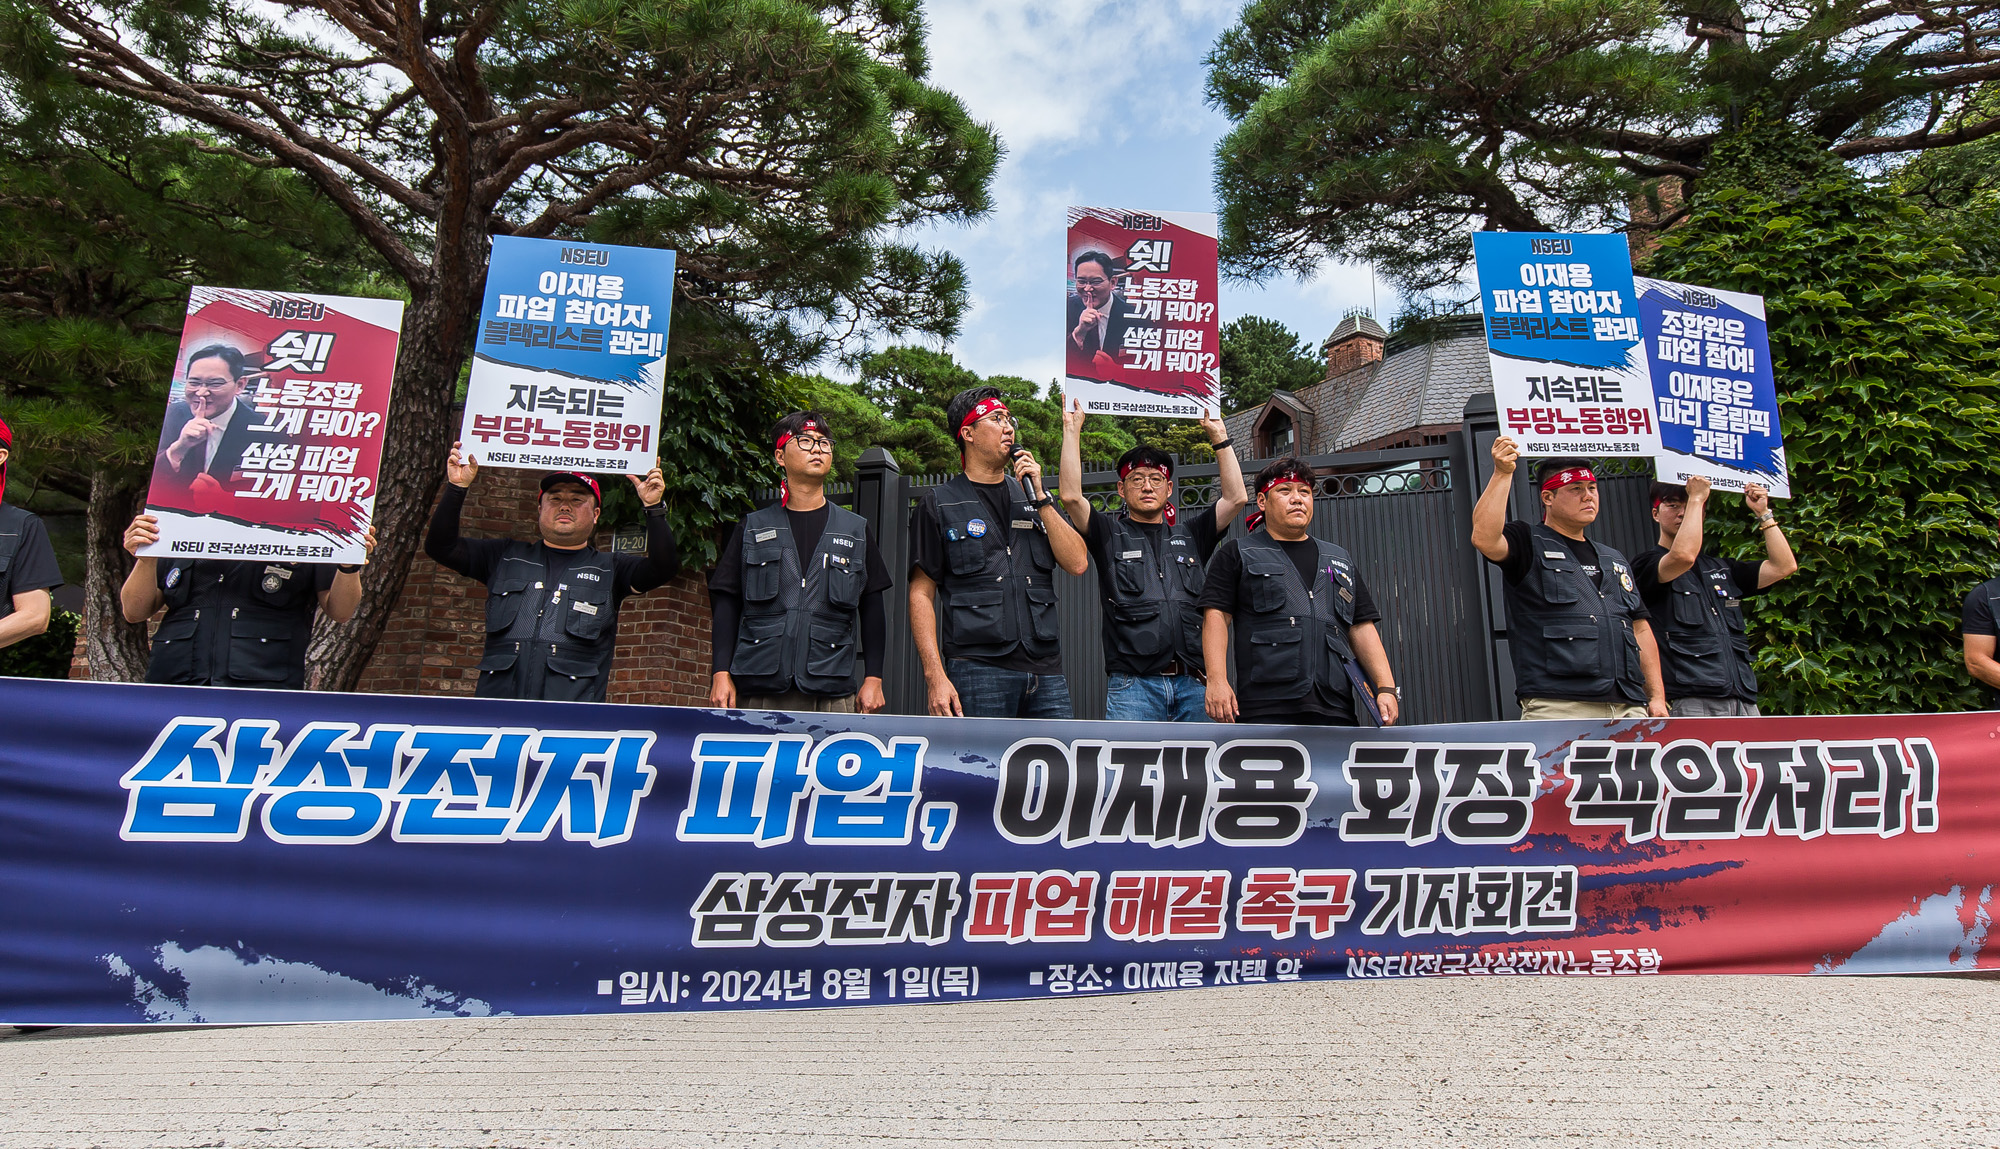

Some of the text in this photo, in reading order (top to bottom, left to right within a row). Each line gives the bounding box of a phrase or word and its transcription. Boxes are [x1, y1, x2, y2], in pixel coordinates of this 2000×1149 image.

[1122, 215, 1163, 231] NSEU
[560, 247, 610, 267] NSEU
[1127, 240, 1173, 272] 쉿!
[1531, 238, 1573, 256] NSEU
[538, 270, 625, 300] 이재용
[1123, 276, 1198, 300] 노동조합
[1520, 262, 1593, 288] 이재용
[267, 300, 326, 321] NSEU
[496, 294, 652, 329] 파업 참여자
[1123, 299, 1215, 323] 그게 뭐야?
[1492, 289, 1622, 315] 파업 참여자
[1682, 290, 1718, 309] NSEU
[483, 320, 663, 358] 블랙리스트 관리!
[1122, 326, 1204, 351] 삼성 파업
[1489, 316, 1640, 342] 블랙리스트 관리!
[1661, 309, 1746, 345] 조합원은
[263, 331, 335, 373] 쉿!
[1122, 349, 1215, 373] 그게 뭐야?
[1657, 335, 1755, 374] 파업 참여!
[252, 378, 363, 409] 노동조합
[506, 384, 625, 418] 지속되는
[1525, 376, 1623, 403] 지속되는
[1669, 371, 1753, 408] 이재용은
[247, 406, 381, 438] 그게 뭐야?
[1088, 401, 1198, 415] NSEU 전국삼성전자노동조합
[1506, 407, 1653, 436] 부당노동행위
[1658, 397, 1771, 437] 파리 올림픽
[471, 414, 651, 453] 부당노동행위
[1527, 442, 1640, 453] NSEU 전국삼성전자노동조합
[1692, 429, 1743, 461] 관람!
[240, 442, 360, 474] 삼성 파업
[487, 451, 629, 470] NSEU 전국삼성전자노동조합
[234, 471, 371, 503] 그게 뭐야?
[171, 540, 334, 558] NSEU 전국삼성전자노동조합
[616, 536, 645, 550] 12-20
[833, 537, 853, 548] NSEU
[577, 572, 600, 582] NSEU
[121, 717, 1939, 850] 삼성전자 파업, 이재용 회장 책임져라!
[691, 865, 1579, 948] 삼성전자 파업 해결 촉구 기자회견
[619, 971, 690, 1005] 일시:
[702, 969, 812, 1003] 2024년
[822, 968, 871, 1000] 8월
[884, 966, 980, 998] 1일(목)
[1048, 964, 1112, 993] 장소:
[1123, 961, 1204, 989] 이재용
